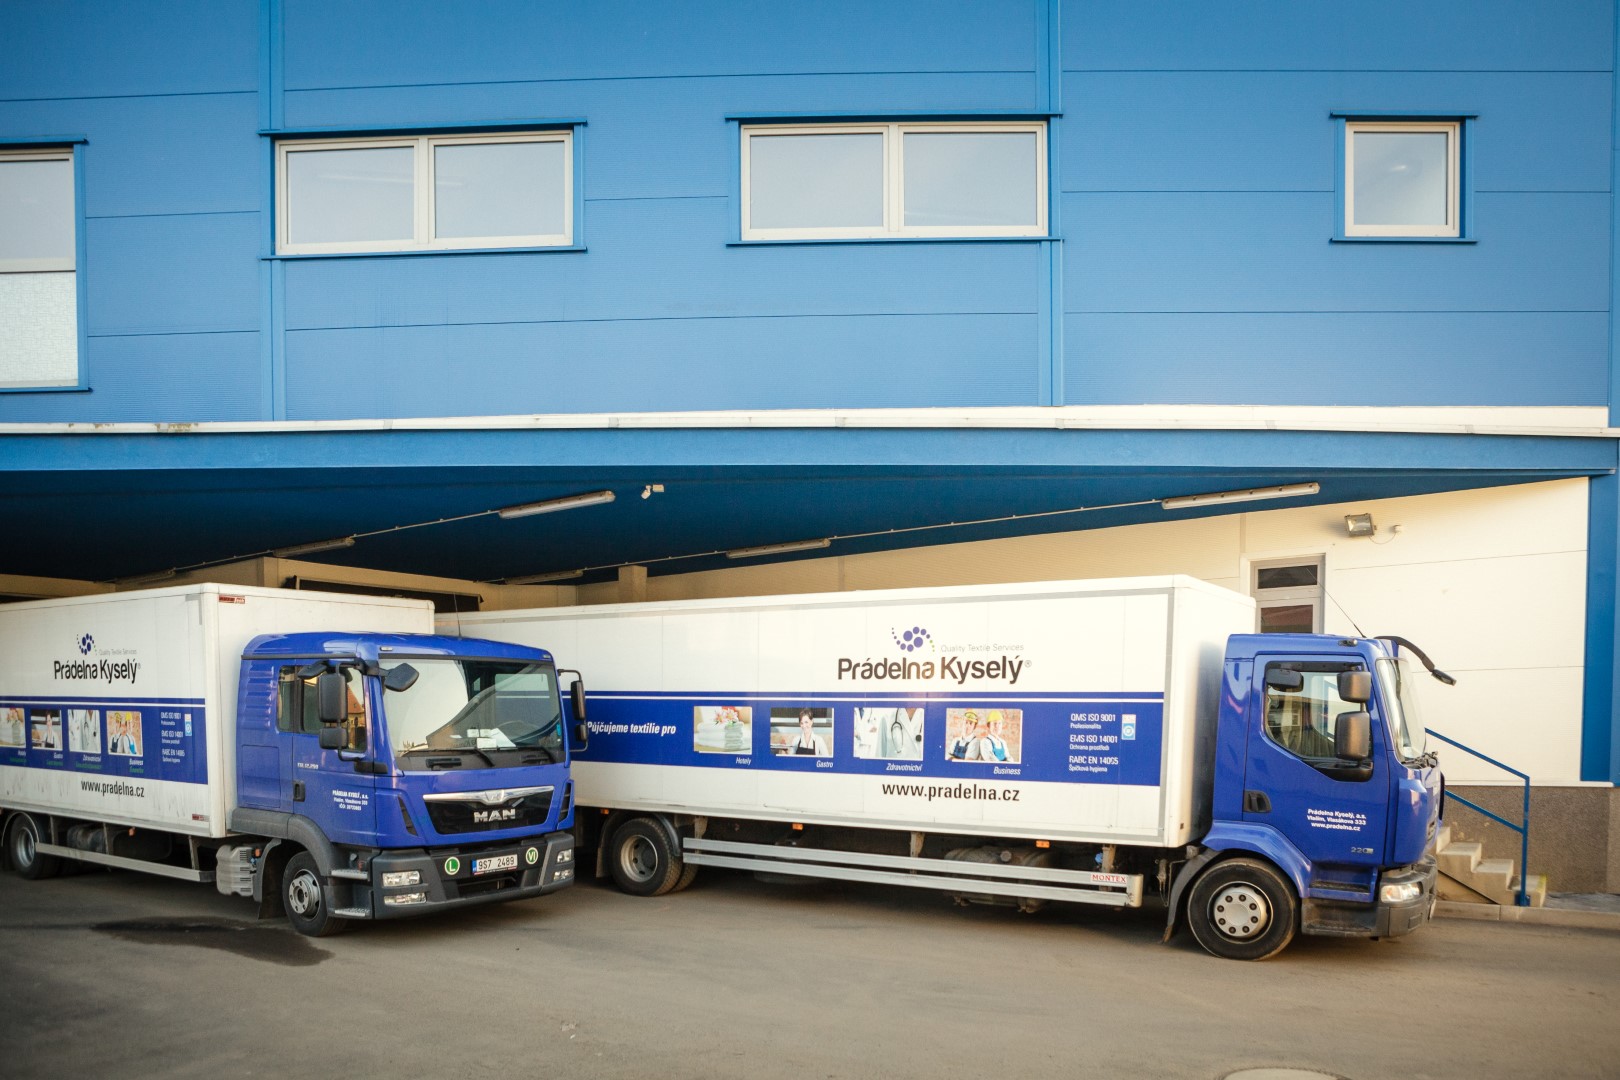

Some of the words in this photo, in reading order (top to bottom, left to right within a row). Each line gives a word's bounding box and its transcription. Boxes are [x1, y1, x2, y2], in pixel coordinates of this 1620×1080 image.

[941, 644, 966, 653] Quality
[968, 644, 990, 652] Textile
[992, 643, 1024, 652] Services
[54, 660, 98, 680] Prádelna
[838, 657, 935, 680] Prádelna
[1070, 713, 1087, 722] QMS
[1088, 713, 1100, 722] ISO
[1100, 713, 1116, 722] 9001
[587, 721, 629, 735] Půjčujeme
[630, 723, 660, 734] textilie
[661, 725, 677, 737] pro
[1069, 735, 1086, 743] EMS
[1086, 735, 1098, 743] ISO
[1099, 735, 1118, 744] 14001
[736, 756, 752, 766] Hotely
[816, 759, 834, 769] Gastro
[1068, 755, 1088, 764] RABC
[1088, 756, 1098, 765] EN
[886, 762, 923, 772] Zdravotnictví
[993, 766, 1021, 776] Business
[81, 780, 145, 798] www.pradelna.cz
[882, 783, 1020, 802] www.pradelna.cz
[473, 808, 516, 823] MAN
[1307, 808, 1334, 816] Prádelna
[1310, 822, 1361, 831] www.pradelna.cz
[448, 860, 456, 869] L
[478, 859, 492, 870] 9S7
[497, 856, 515, 867] 2489
[1092, 874, 1126, 882] MONTEX
